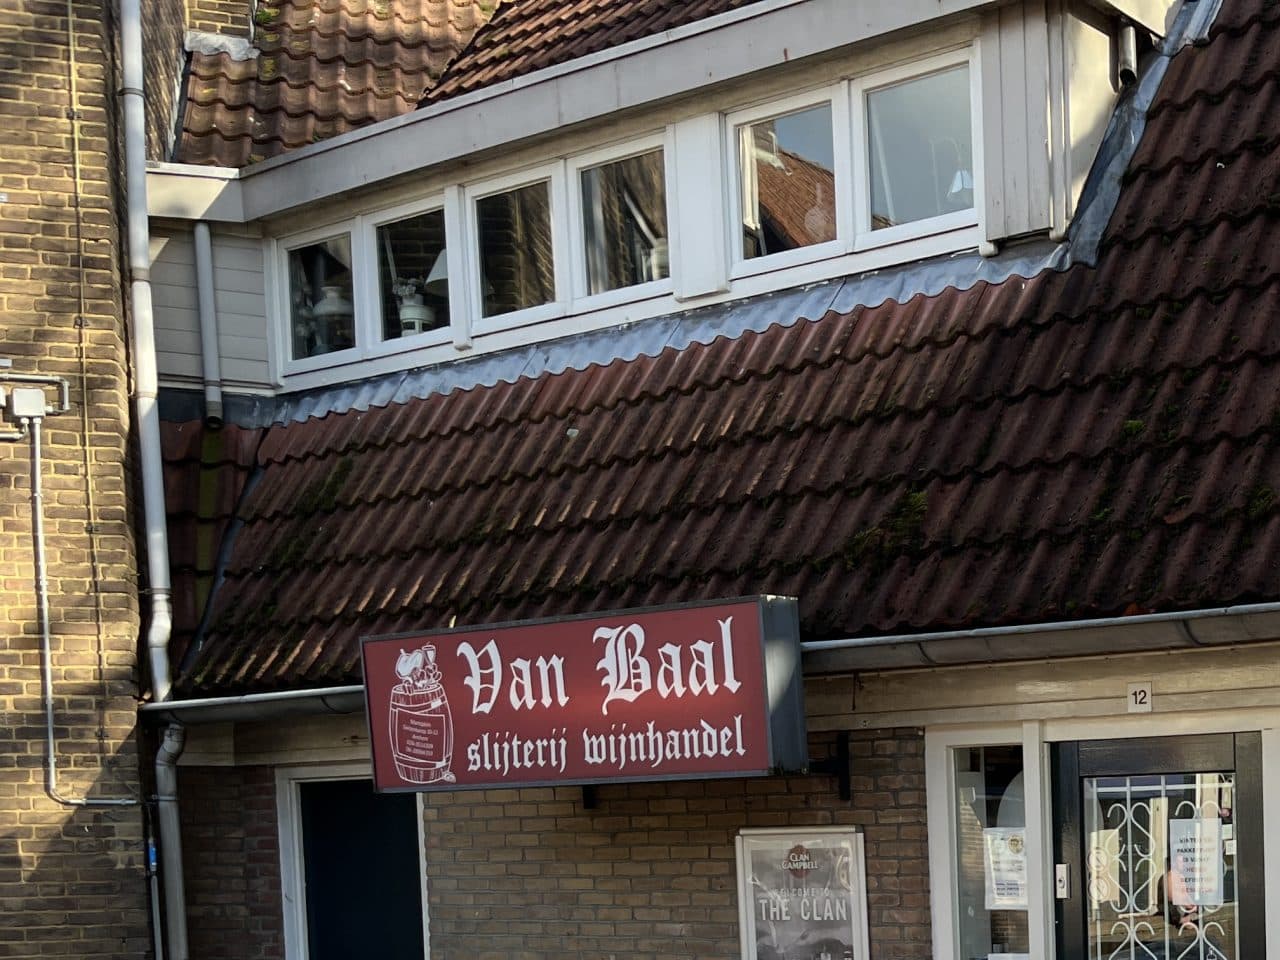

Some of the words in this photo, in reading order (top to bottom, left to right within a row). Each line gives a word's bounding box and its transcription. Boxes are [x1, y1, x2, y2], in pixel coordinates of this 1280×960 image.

[457, 639, 569, 714] Van
[592, 616, 741, 715] Baal
[1131, 689, 1147, 705] 12
[467, 727, 567, 776] slijterij
[583, 714, 746, 769] wijnhandel
[782, 861, 819, 870] CAMPBELL
[790, 853, 810, 862] CLAN
[759, 898, 792, 921] THE
[800, 898, 848, 921] CLAN
